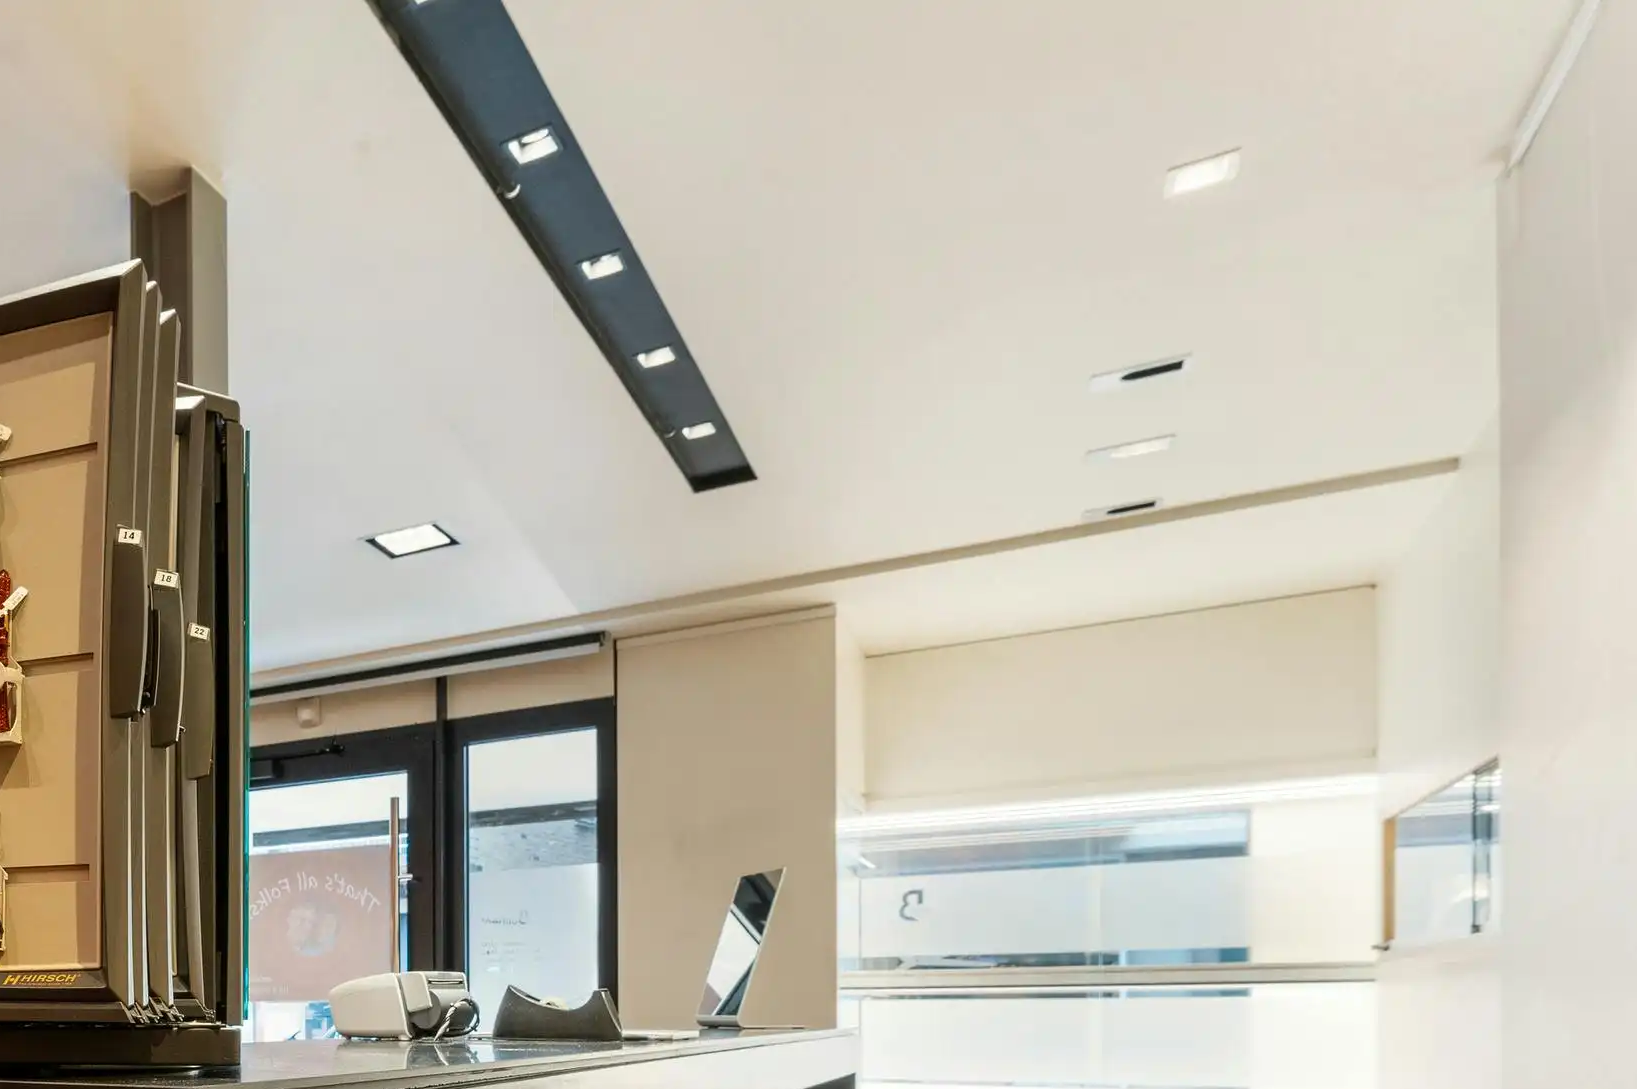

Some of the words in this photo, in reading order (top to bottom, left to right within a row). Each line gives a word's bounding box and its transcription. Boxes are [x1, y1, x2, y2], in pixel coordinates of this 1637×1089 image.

[123, 531, 135, 540] 14
[161, 574, 172, 583] 18
[194, 626, 205, 636] 22
[20, 974, 77, 982] HIRSCH
